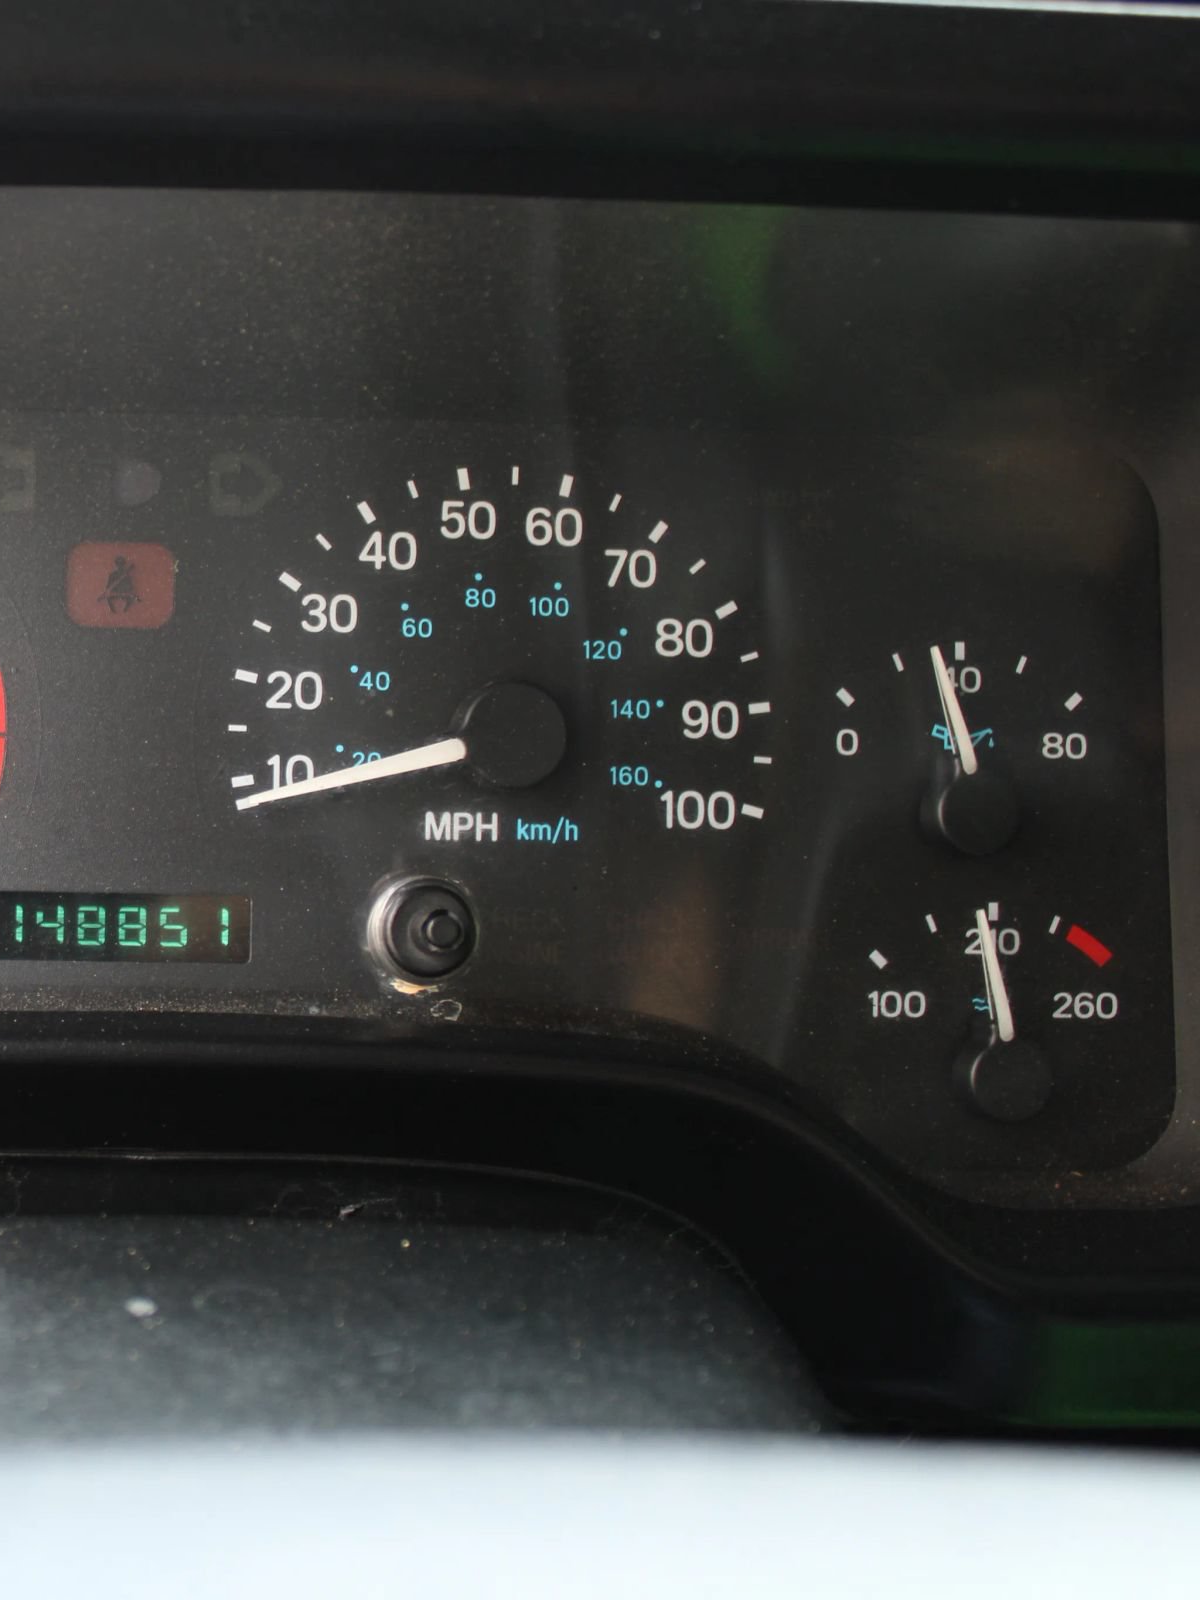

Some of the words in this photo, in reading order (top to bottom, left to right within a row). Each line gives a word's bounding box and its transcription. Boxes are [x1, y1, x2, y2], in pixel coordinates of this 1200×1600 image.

[440, 500, 497, 540] 50
[525, 507, 583, 547] 60
[358, 530, 417, 571] 40
[604, 549, 657, 589] 70
[301, 593, 358, 634] 30
[465, 588, 496, 608] 80
[529, 596, 569, 617] 100
[402, 618, 433, 638] 60
[655, 618, 714, 658] 80
[583, 640, 622, 660] 120
[265, 670, 323, 710] 20
[359, 671, 390, 691] 40
[611, 699, 650, 719] 140
[681, 700, 740, 740] 90
[836, 728, 859, 756] 0
[1041, 732, 1087, 760] 80
[266, 754, 315, 791] 10
[610, 766, 649, 786] 160
[660, 790, 736, 830] 100
[424, 811, 499, 842] MPH
[516, 816, 579, 843] km/h
[14, 905, 230, 948] 148851
[868, 990, 926, 1018] 100
[1052, 992, 1118, 1019] 260
